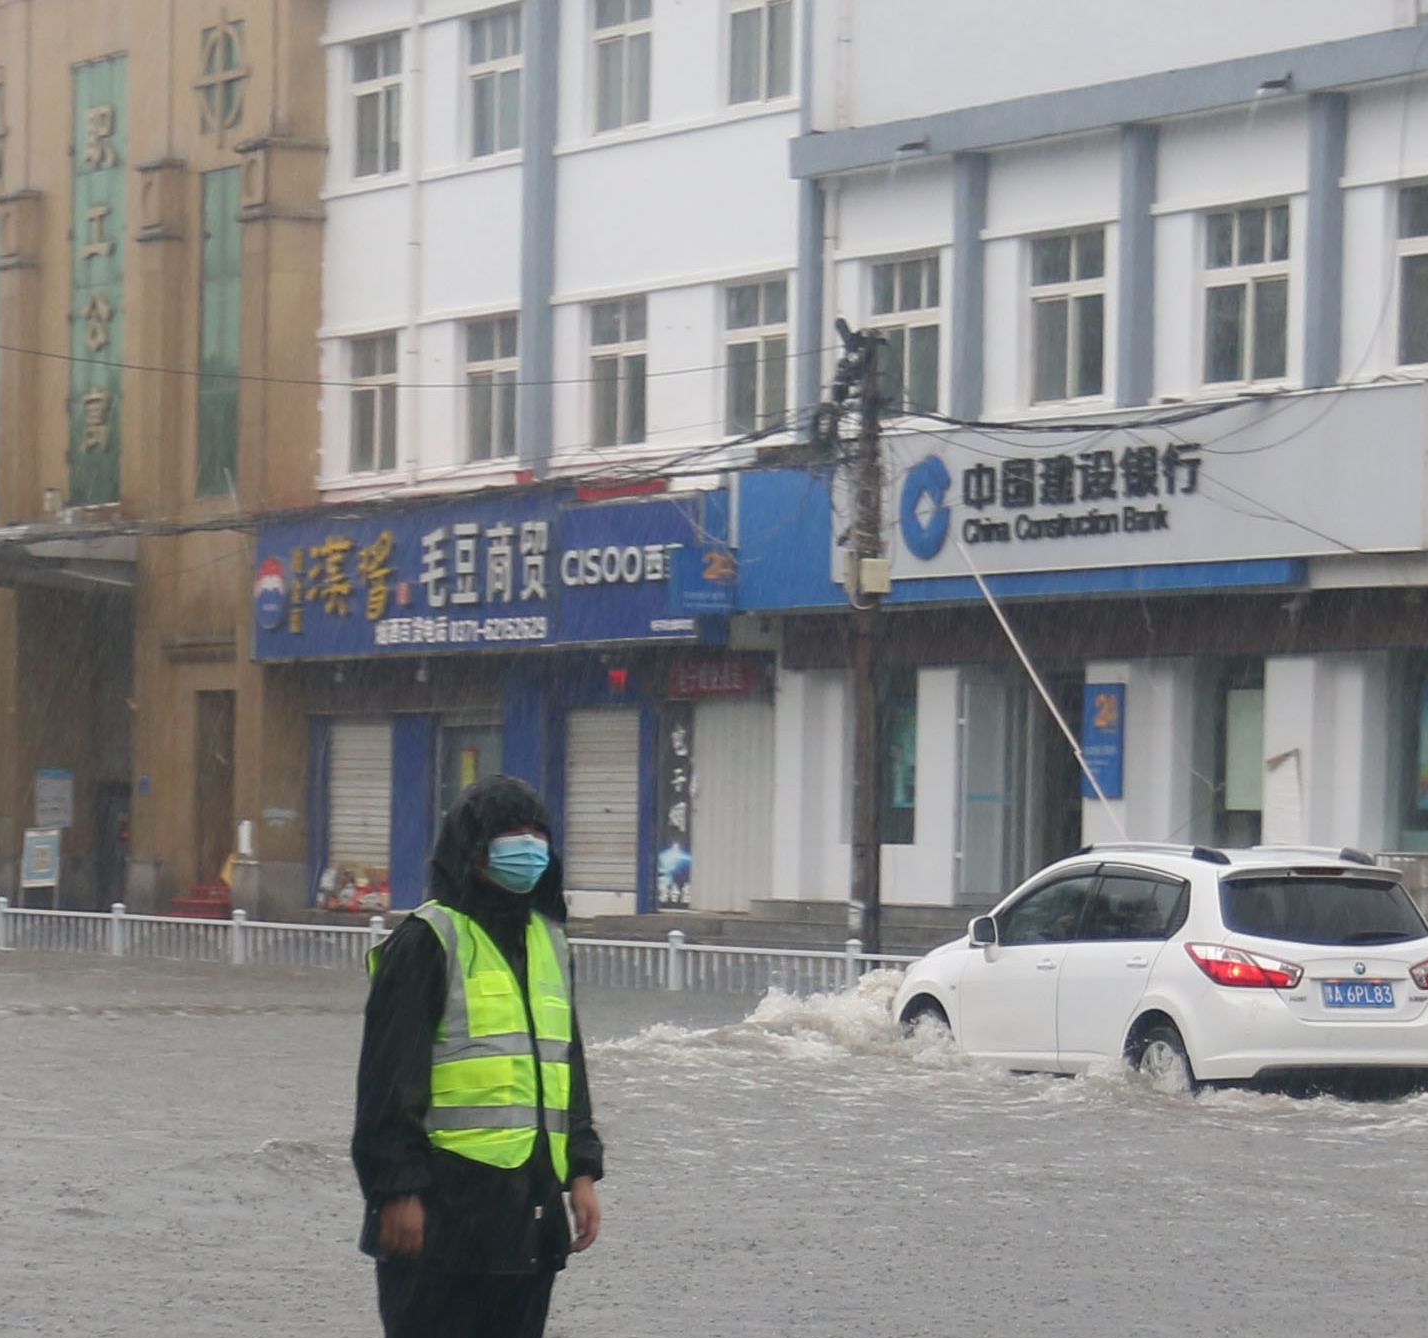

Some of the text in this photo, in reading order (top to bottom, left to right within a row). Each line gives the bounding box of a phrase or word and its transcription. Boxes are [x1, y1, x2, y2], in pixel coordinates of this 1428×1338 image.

[963, 443, 1202, 510] 中国建设银行
[963, 504, 1170, 544] China Construction Bank
[419, 521, 548, 607] 毛豆商贸
